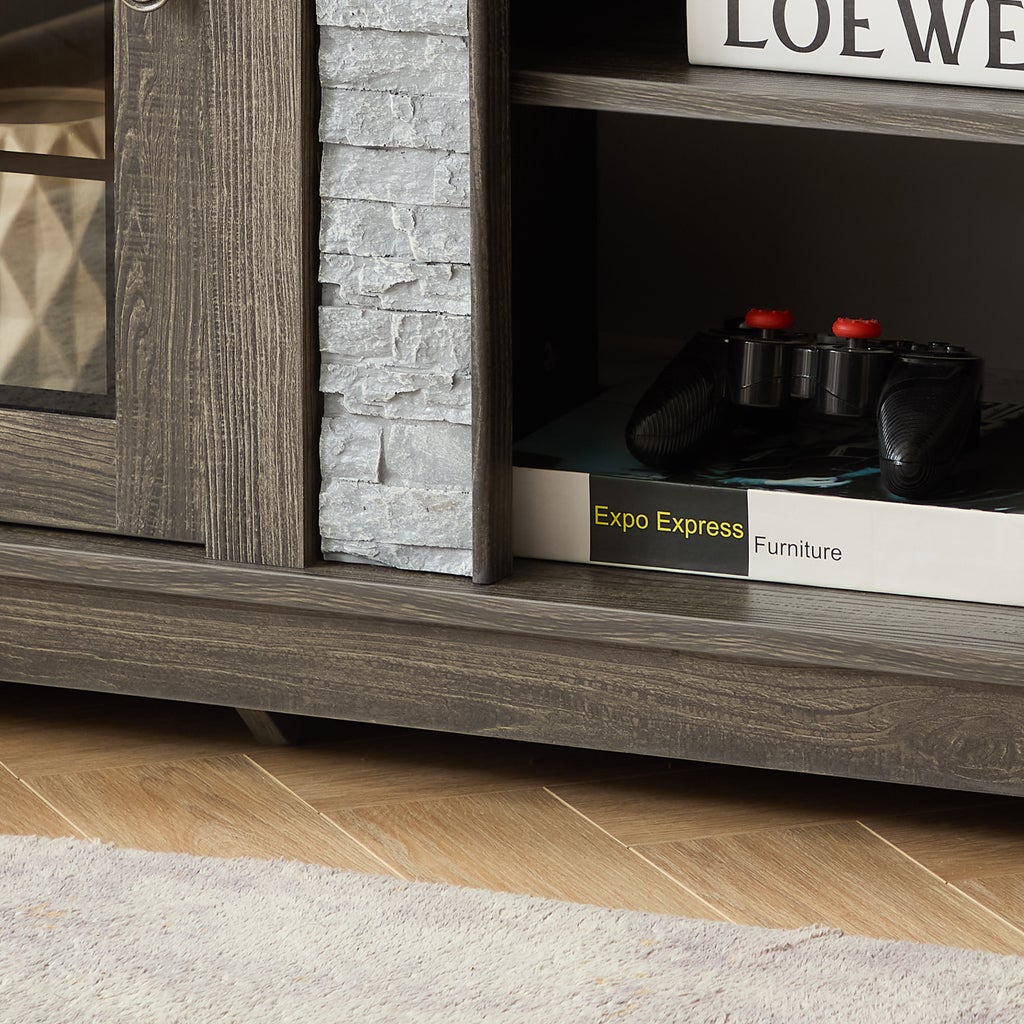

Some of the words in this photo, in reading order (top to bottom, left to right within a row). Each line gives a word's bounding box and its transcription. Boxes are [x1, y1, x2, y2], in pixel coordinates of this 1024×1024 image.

[594, 504, 649, 532] Expo
[656, 510, 745, 539] Express
[754, 535, 842, 562] Furniture
